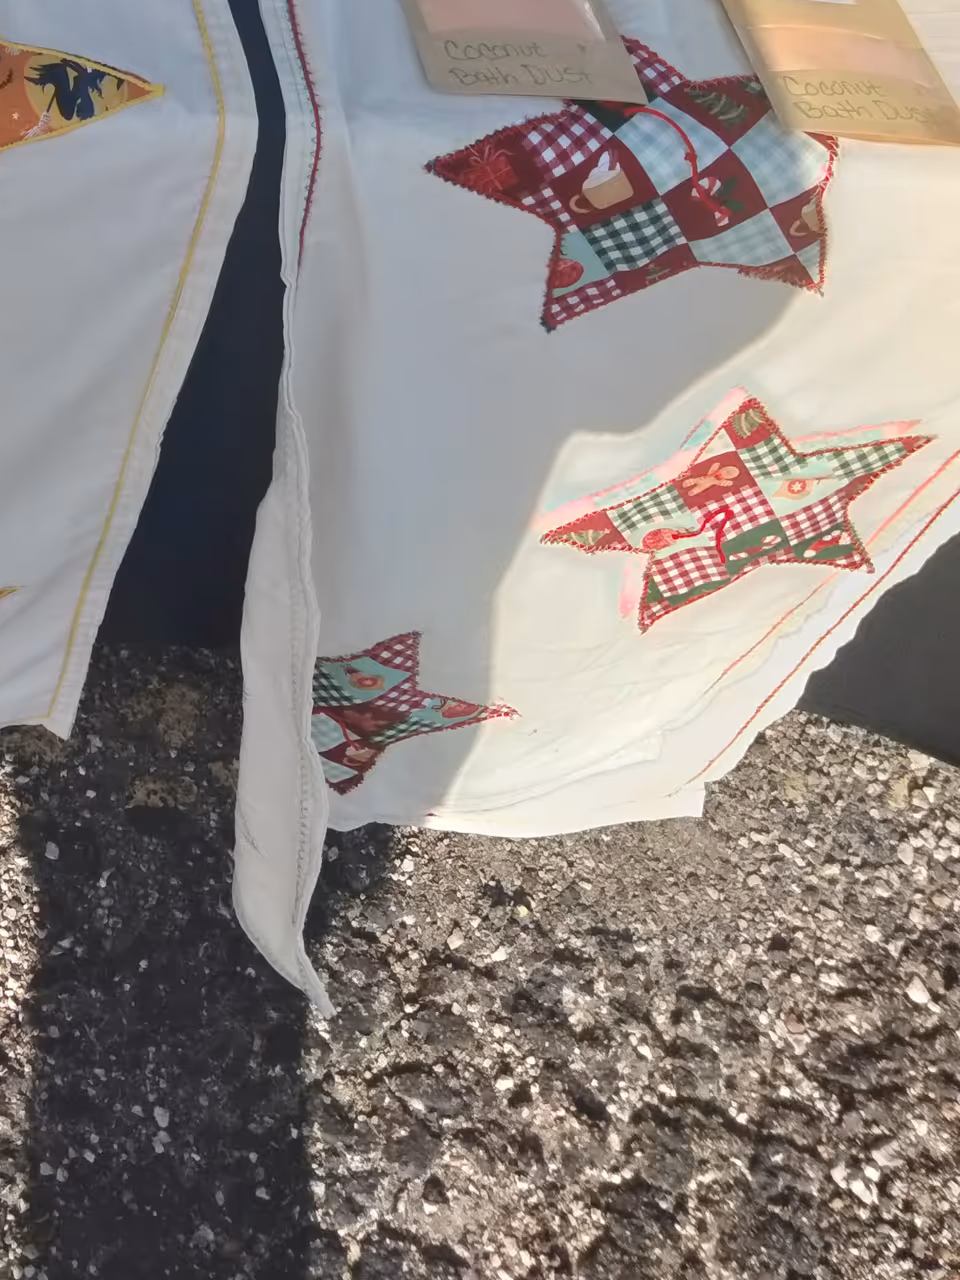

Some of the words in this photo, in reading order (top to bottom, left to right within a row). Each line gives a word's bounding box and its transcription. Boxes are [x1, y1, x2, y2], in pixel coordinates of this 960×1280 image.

[444, 39, 548, 62] Coconut
[448, 66, 519, 86] Bath
[782, 74, 888, 97] Coconut
[792, 99, 873, 121] Bath
